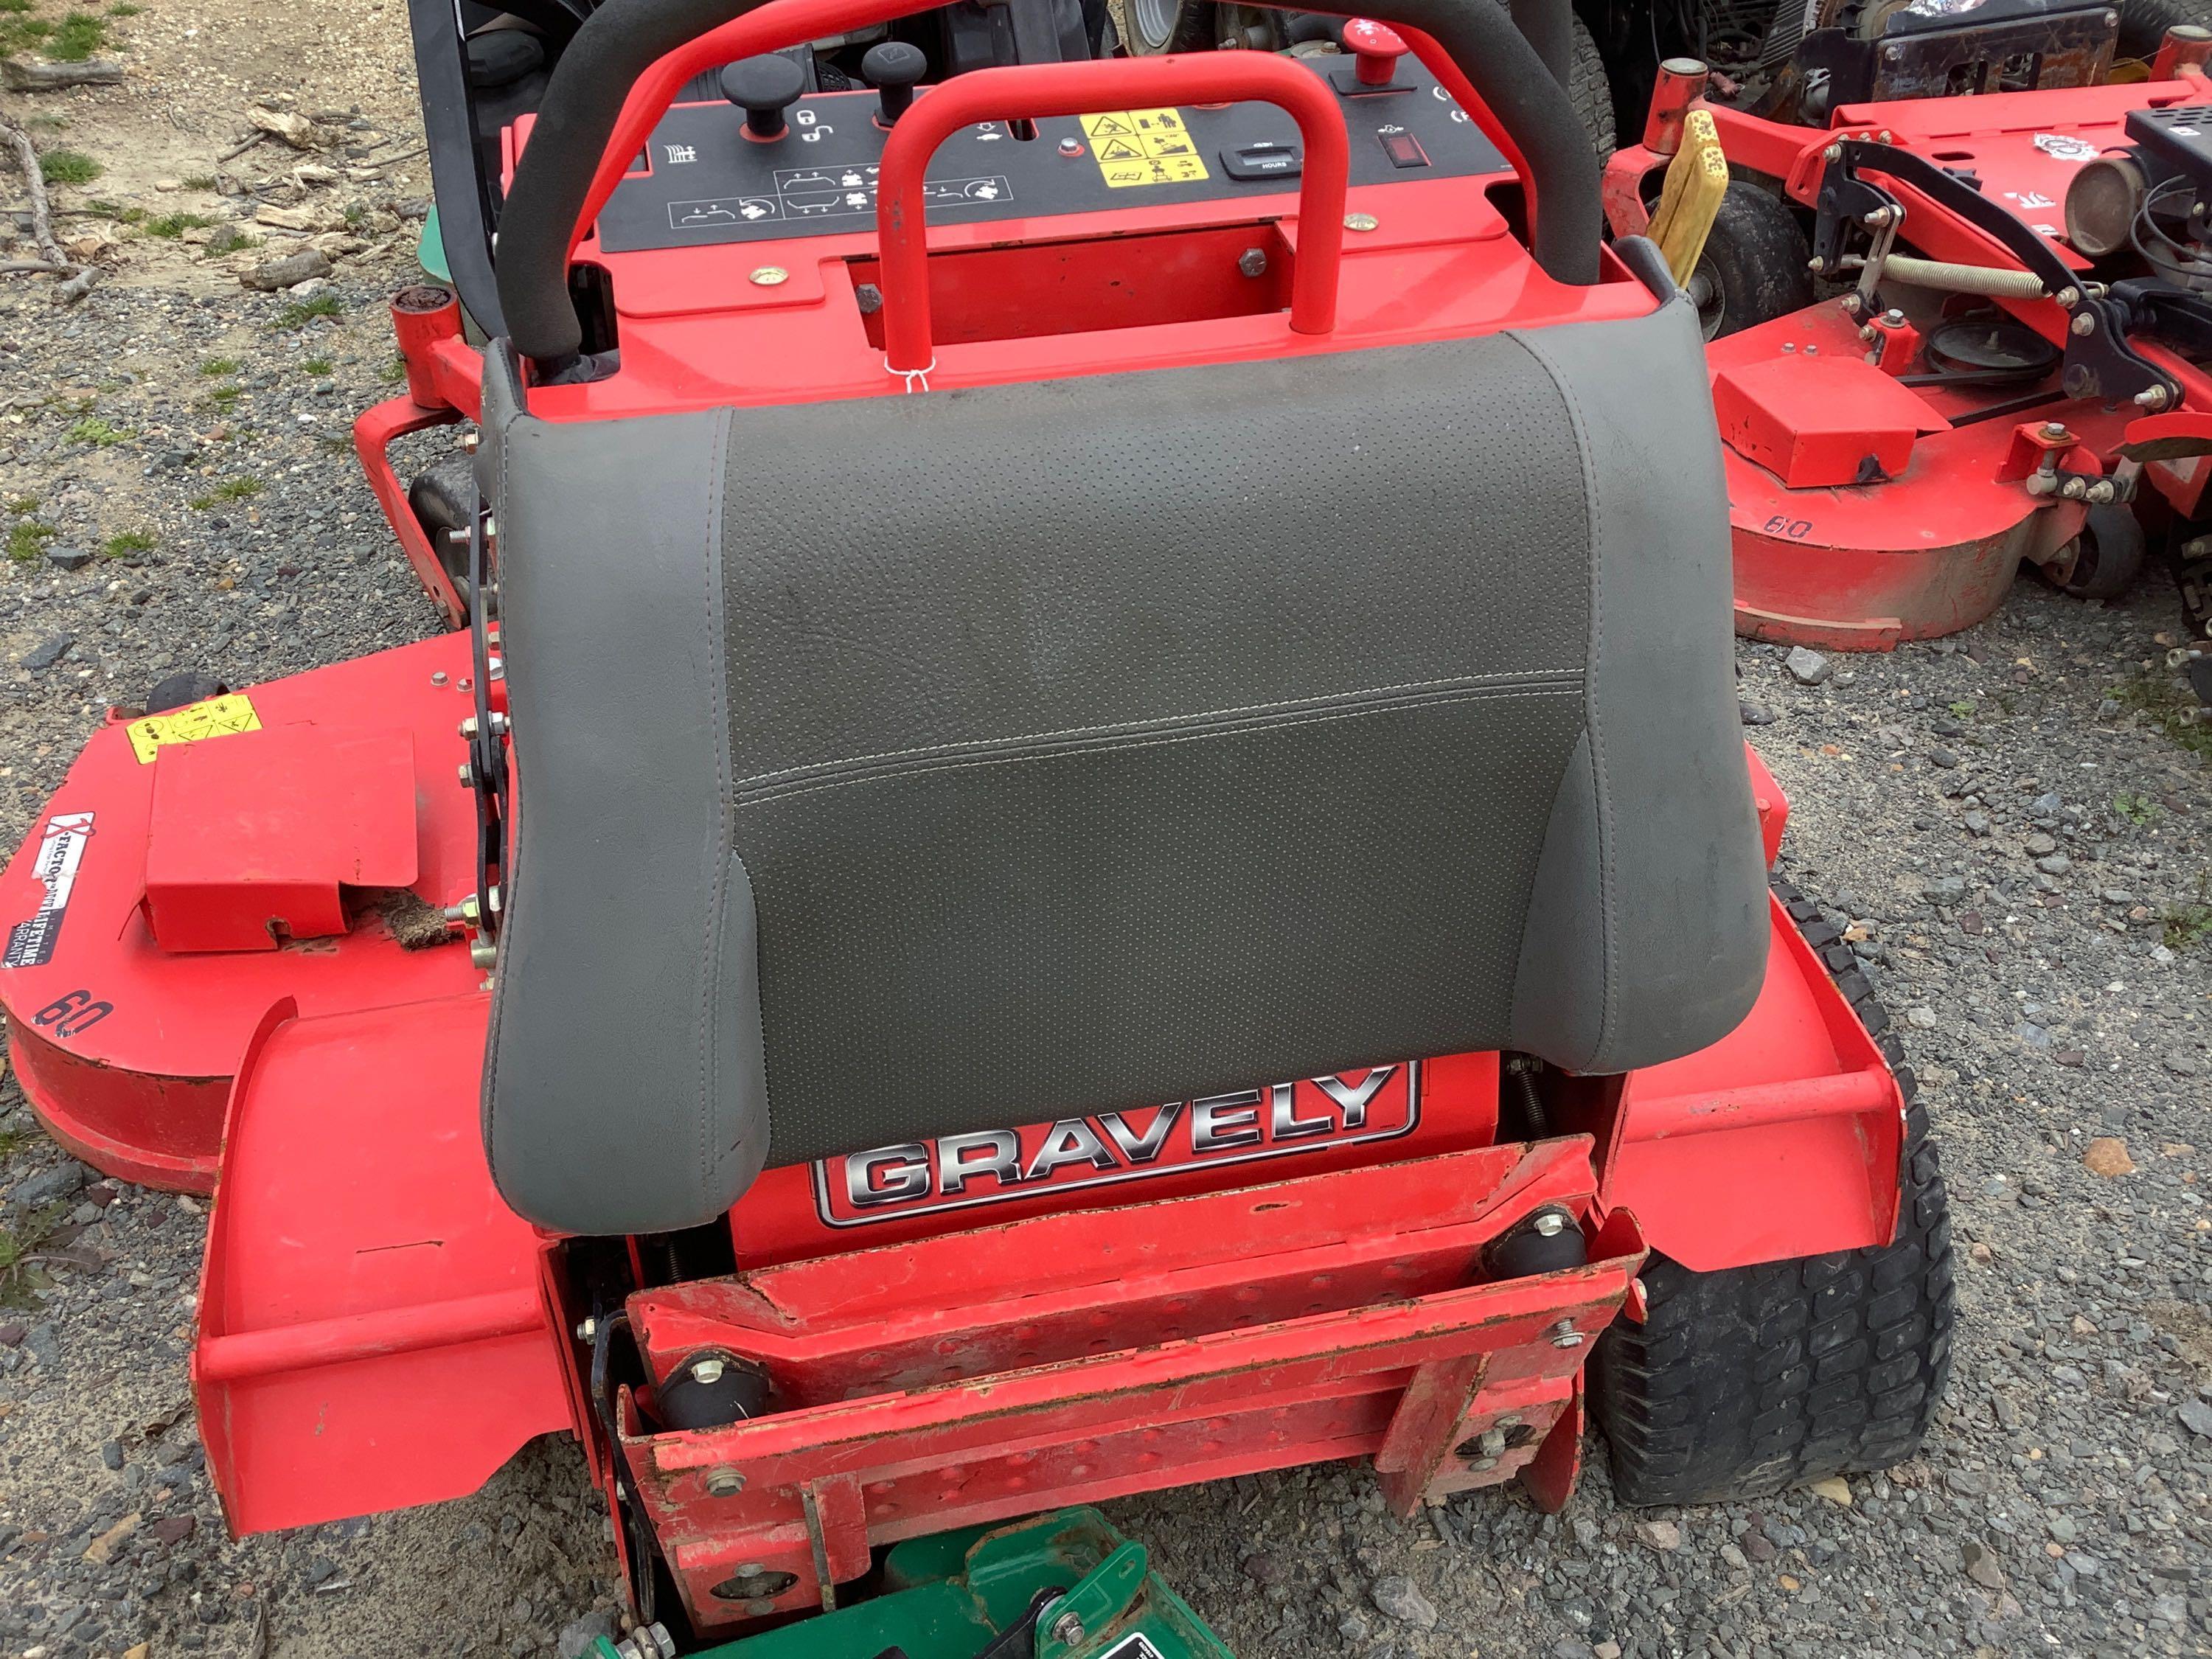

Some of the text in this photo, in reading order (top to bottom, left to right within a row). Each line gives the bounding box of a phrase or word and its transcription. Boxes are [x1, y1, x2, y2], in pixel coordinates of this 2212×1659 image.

[1763, 515, 1813, 539] 60
[20, 911, 51, 966] LIFETIME
[36, 909, 59, 964] LIMITED
[32, 990, 114, 1038] 60
[846, 1065, 1399, 1207] GRAVELY
